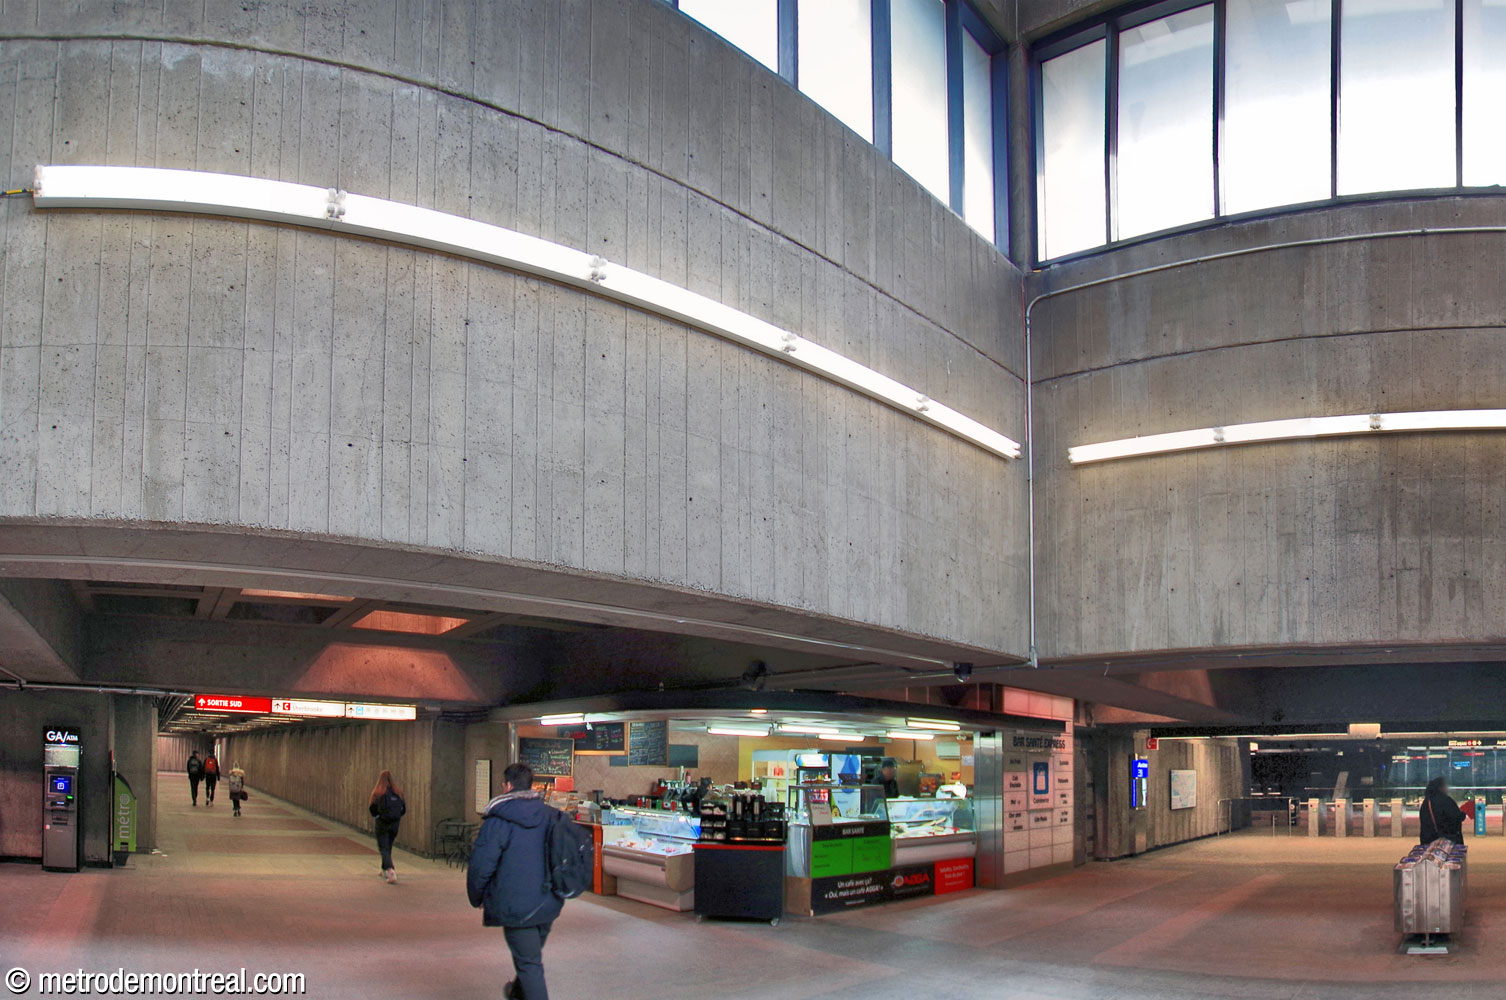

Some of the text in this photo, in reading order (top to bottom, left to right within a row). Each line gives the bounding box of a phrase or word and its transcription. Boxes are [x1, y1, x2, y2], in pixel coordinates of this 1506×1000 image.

[207, 698, 242, 708] SORTIE SUD
[1013, 735, 1065, 750] BAR SANTÉ EXPRESS
[117, 793, 130, 839] métro
[837, 880, 845, 889] Un
[845, 879, 854, 888] café
[839, 888, 849, 897] mais
